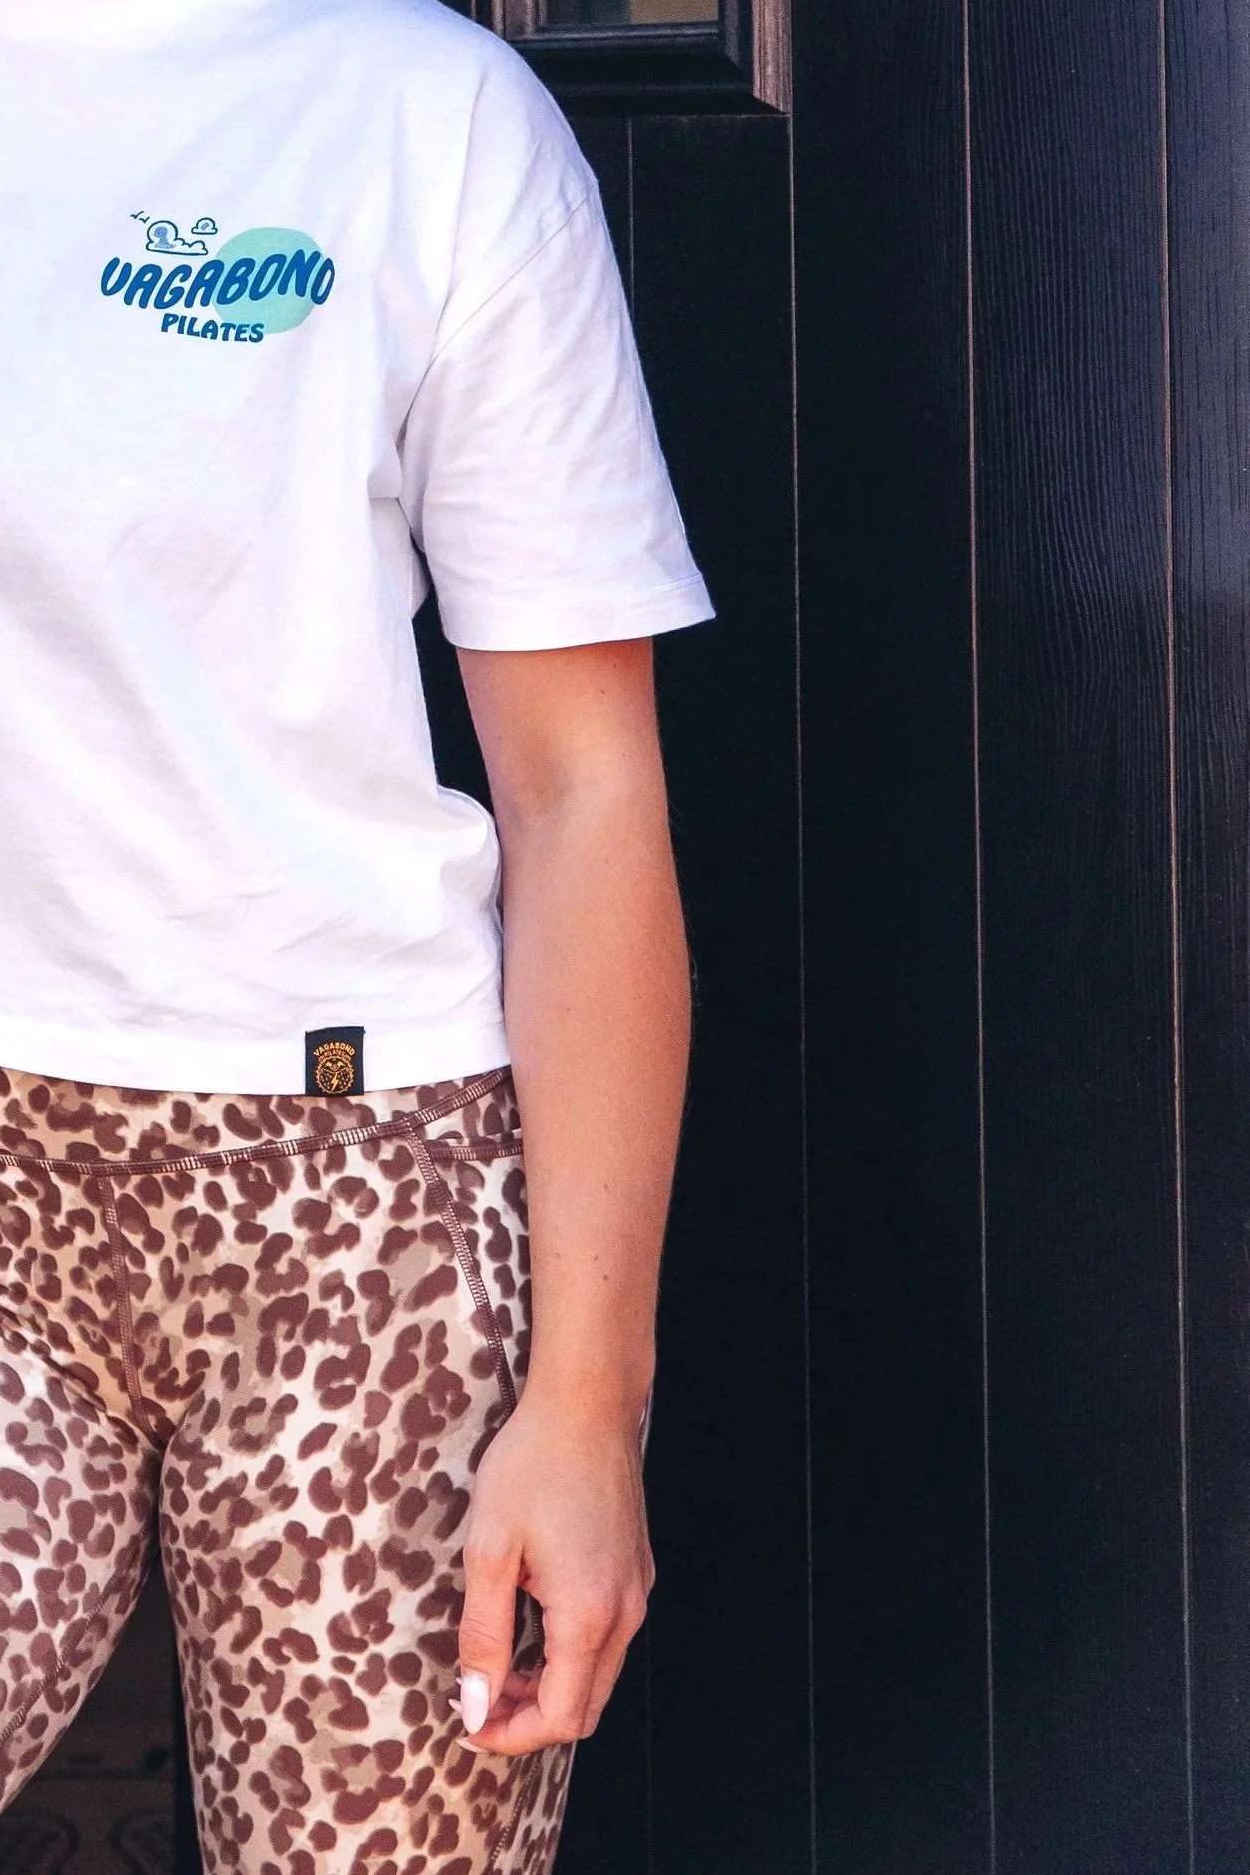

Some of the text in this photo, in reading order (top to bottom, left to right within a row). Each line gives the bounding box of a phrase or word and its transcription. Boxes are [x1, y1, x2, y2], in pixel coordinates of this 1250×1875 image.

[101, 249, 335, 309] VAGABOND
[161, 313, 264, 343] PILATES
[313, 1042, 355, 1056] VAGABOND
